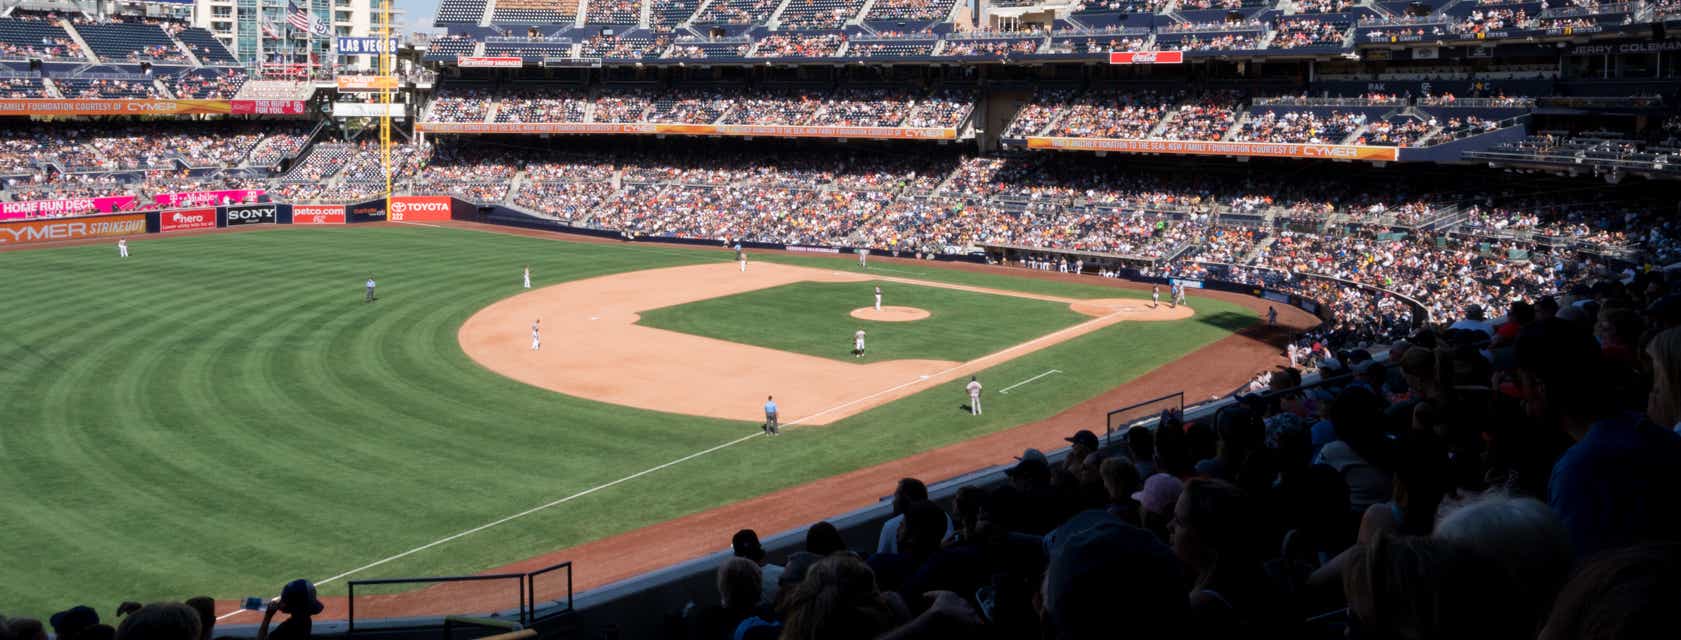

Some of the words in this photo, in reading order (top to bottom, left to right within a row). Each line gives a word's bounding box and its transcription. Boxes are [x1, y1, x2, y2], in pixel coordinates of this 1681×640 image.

[340, 39, 359, 52] LAS
[1572, 46, 1613, 55] JERRY
[28, 103, 73, 111] FOUNDATION
[75, 103, 112, 111] COURTESY
[127, 102, 177, 111] CYMER
[1129, 141, 1137, 149] TO
[1139, 141, 1150, 150] THE
[1184, 143, 1206, 152] FAMILY
[1208, 143, 1249, 153] FOUNDATION
[1251, 145, 1287, 154] COURTESY
[1289, 146, 1297, 154] OF
[1303, 146, 1358, 156] CYMER
[3, 202, 38, 214] HOME
[40, 200, 65, 211] RUN
[66, 199, 96, 210] DECK
[294, 207, 344, 217] petco.com
[406, 202, 449, 212] TOYOTA
[228, 208, 275, 220] SONY
[89, 219, 145, 234] STRIKEOUT
